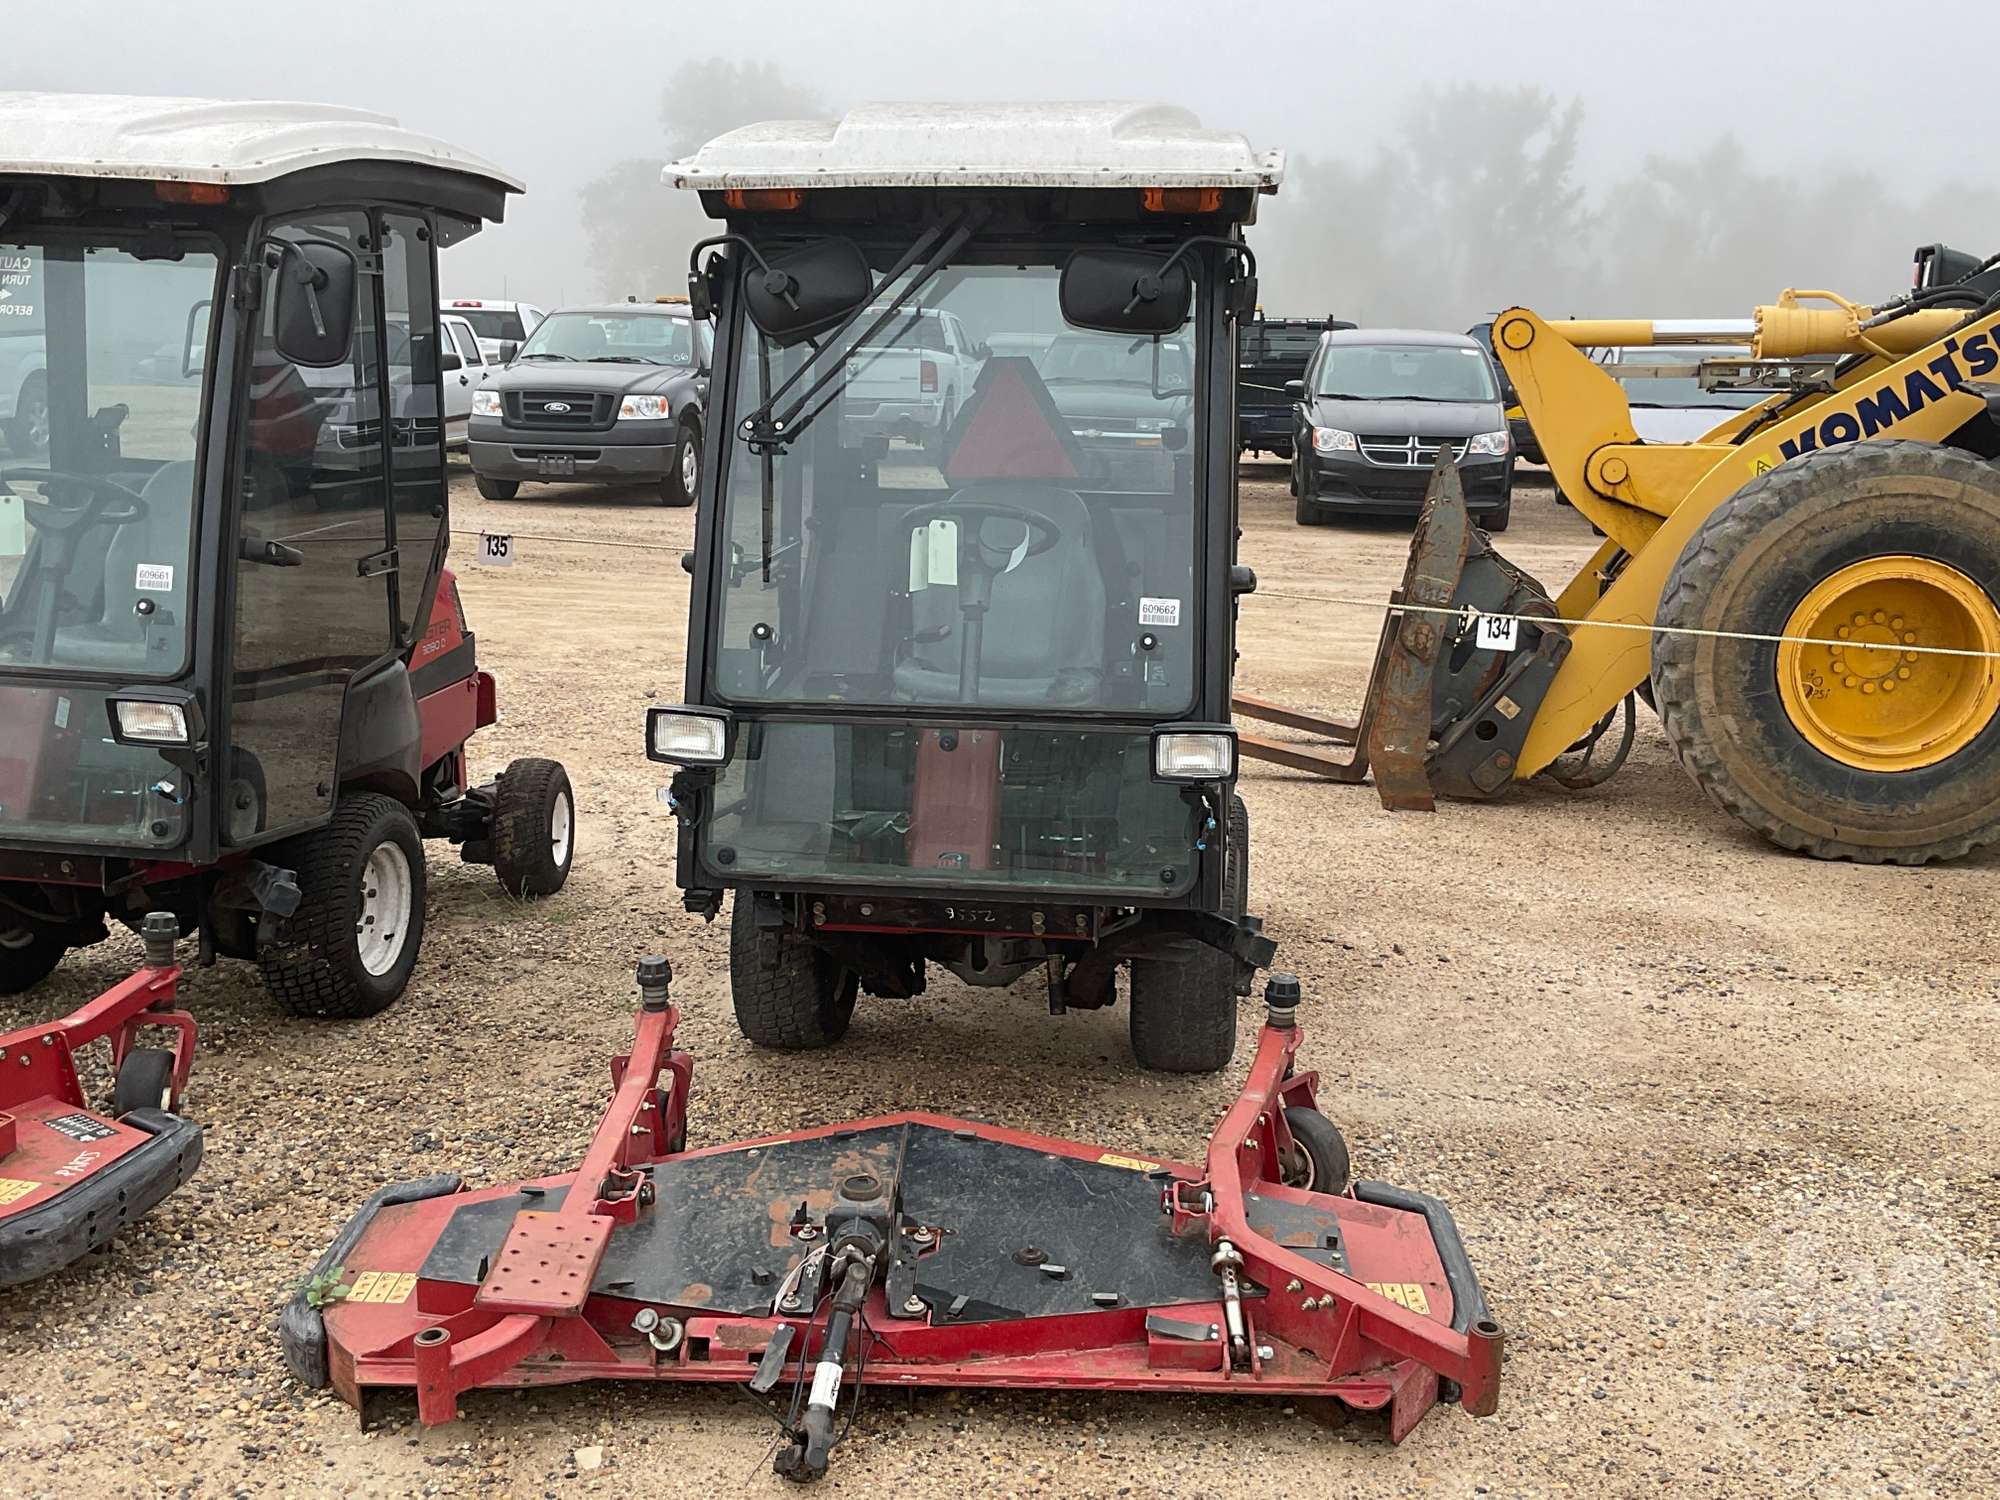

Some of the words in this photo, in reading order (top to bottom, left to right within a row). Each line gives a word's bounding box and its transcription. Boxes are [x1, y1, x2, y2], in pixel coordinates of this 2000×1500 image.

[1779, 324, 2000, 461] KOMATS
[486, 535, 508, 557] 135
[139, 570, 169, 580] 609661
[1142, 603, 1176, 615] 609662
[1487, 617, 1511, 640] 134
